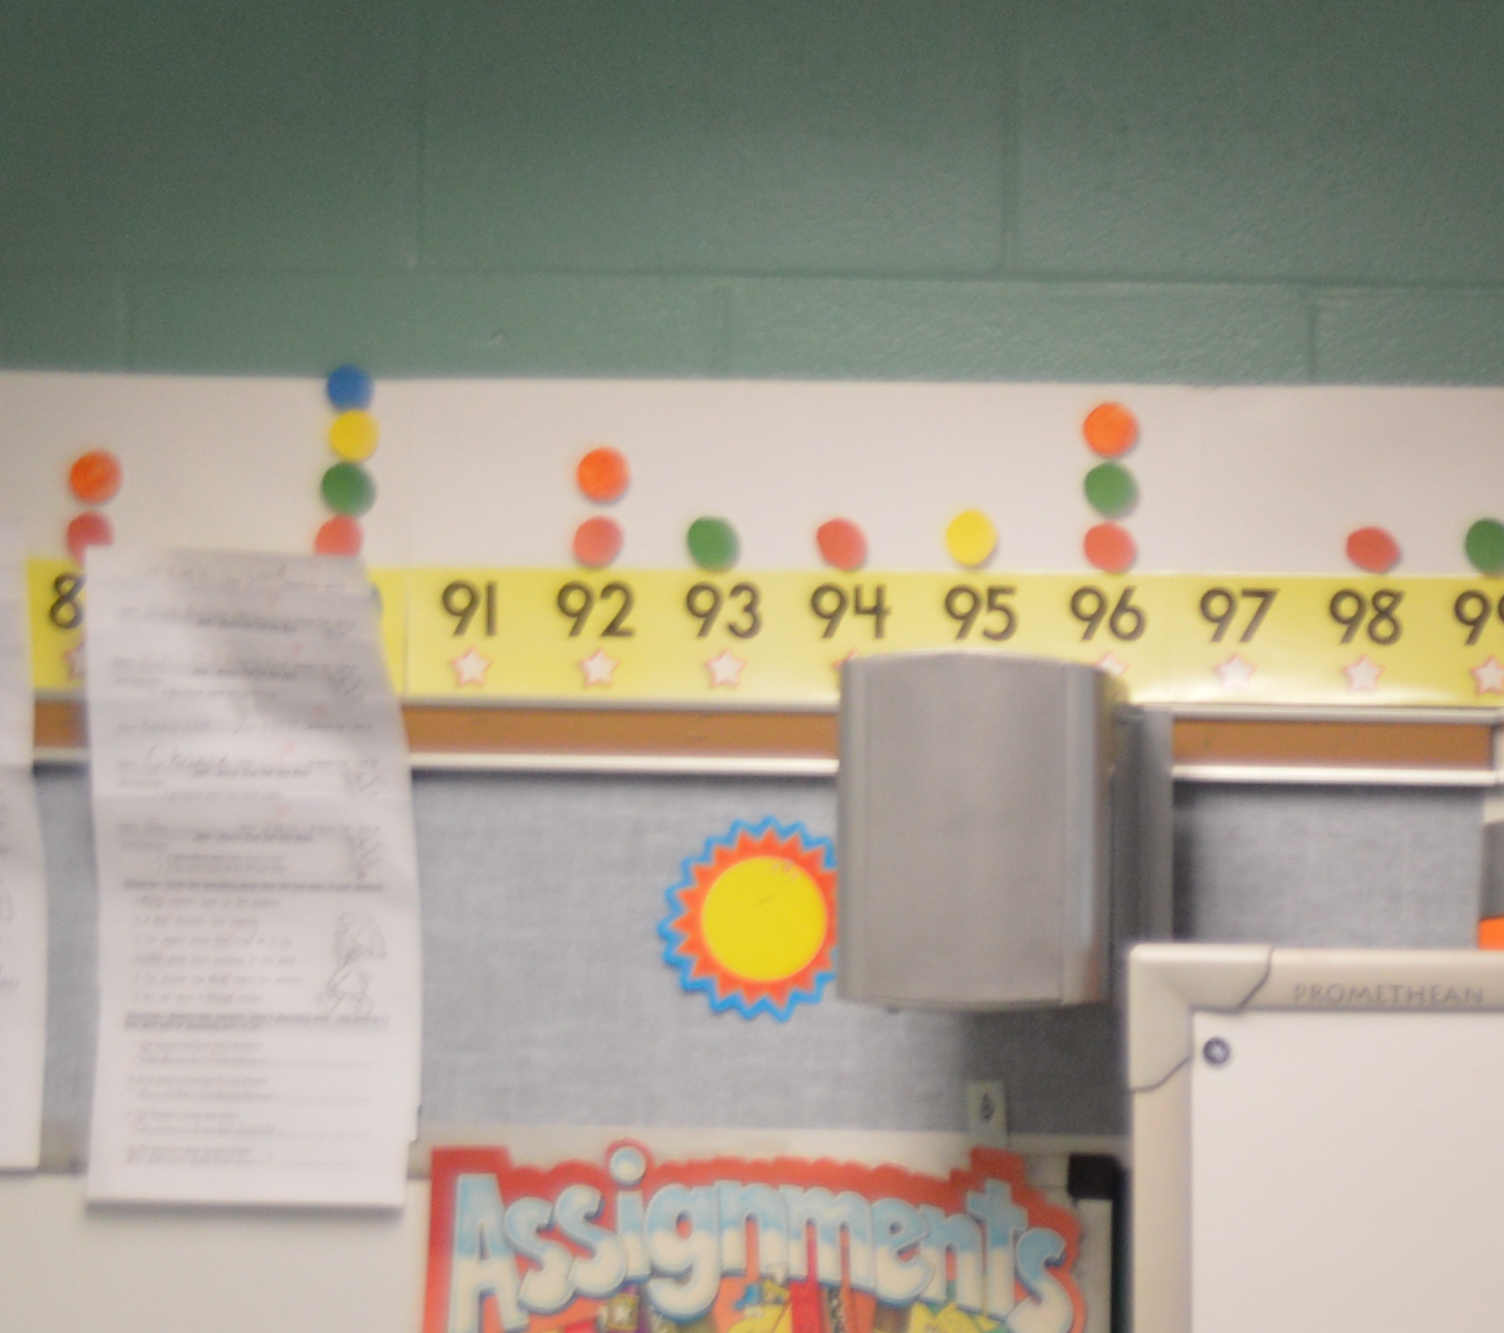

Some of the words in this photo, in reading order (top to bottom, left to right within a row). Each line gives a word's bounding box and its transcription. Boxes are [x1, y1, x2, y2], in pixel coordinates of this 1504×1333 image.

[440, 580, 496, 636] 91
[556, 581, 633, 637] 92
[684, 582, 761, 639] 93
[809, 583, 889, 638] 94
[943, 584, 1016, 641] 95
[1069, 586, 1145, 641] 96
[1199, 587, 1278, 642] 97
[1328, 588, 1403, 645] 98
[1295, 984, 1484, 1004] PROMETHEAN
